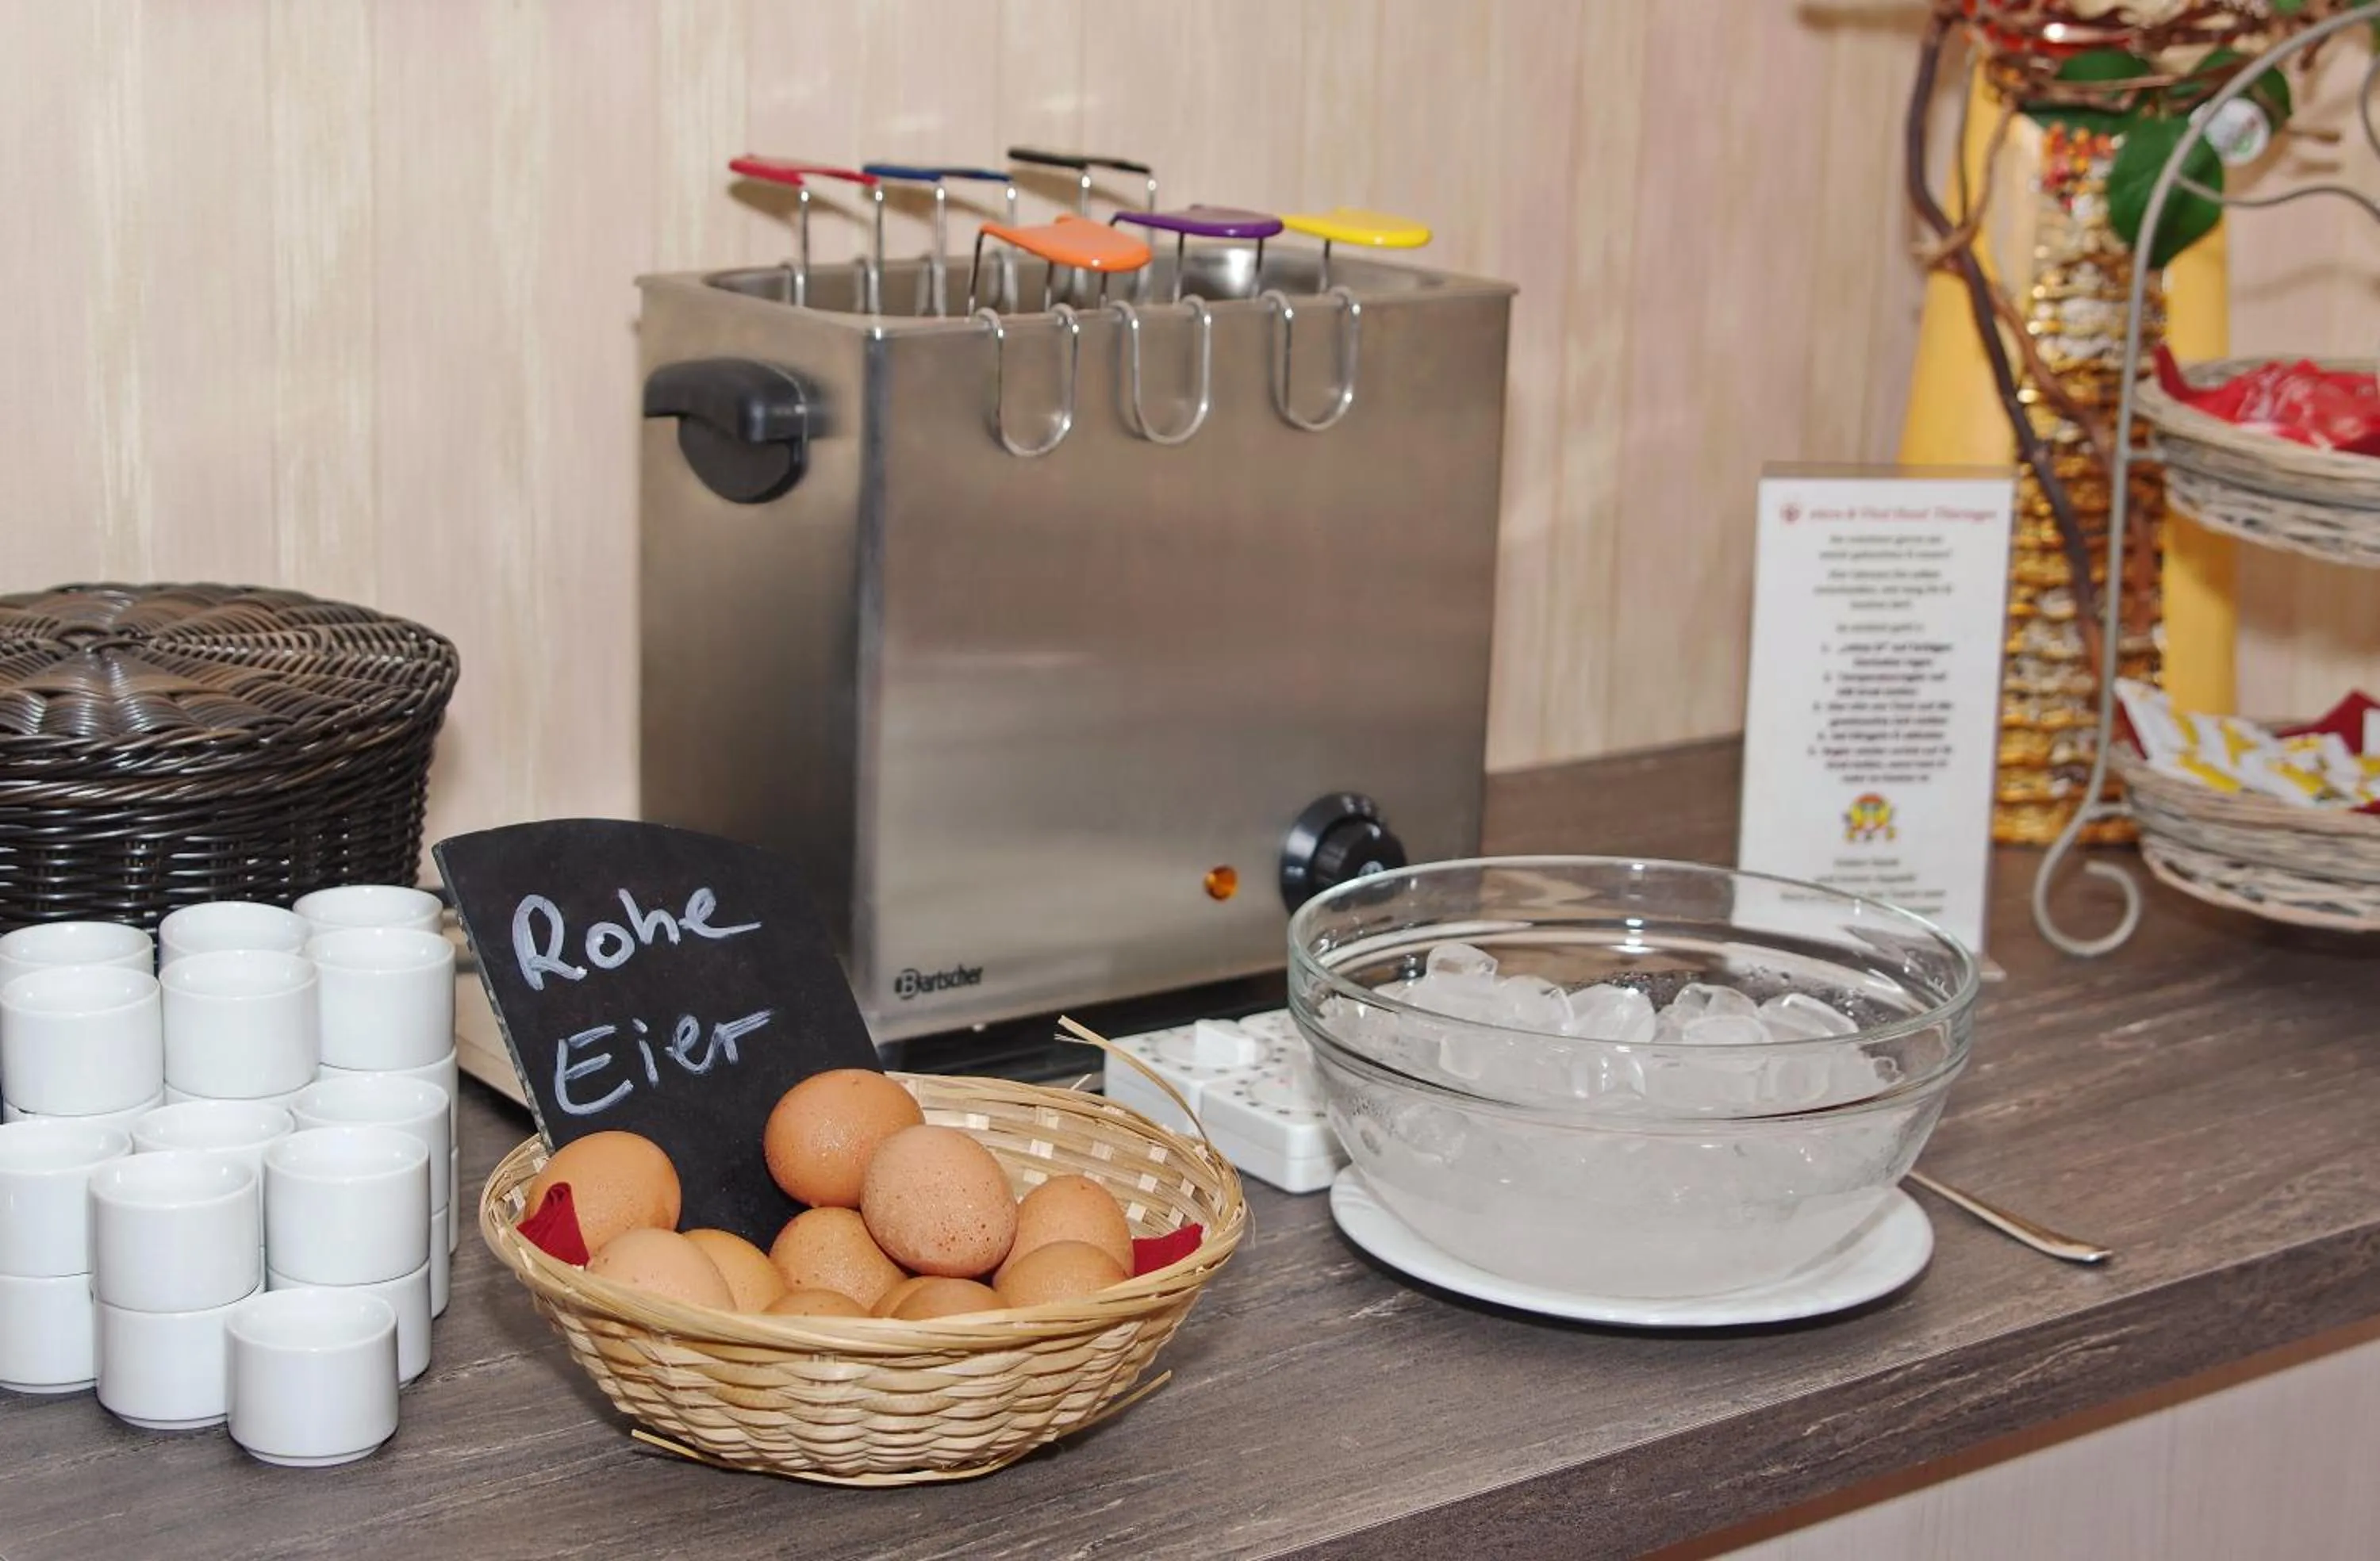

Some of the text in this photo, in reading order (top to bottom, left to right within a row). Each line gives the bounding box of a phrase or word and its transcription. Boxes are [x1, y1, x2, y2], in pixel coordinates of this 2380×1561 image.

[512, 888, 762, 991] Rohe
[894, 964, 983, 1001] Bartscher
[555, 1009, 774, 1115] Eier
